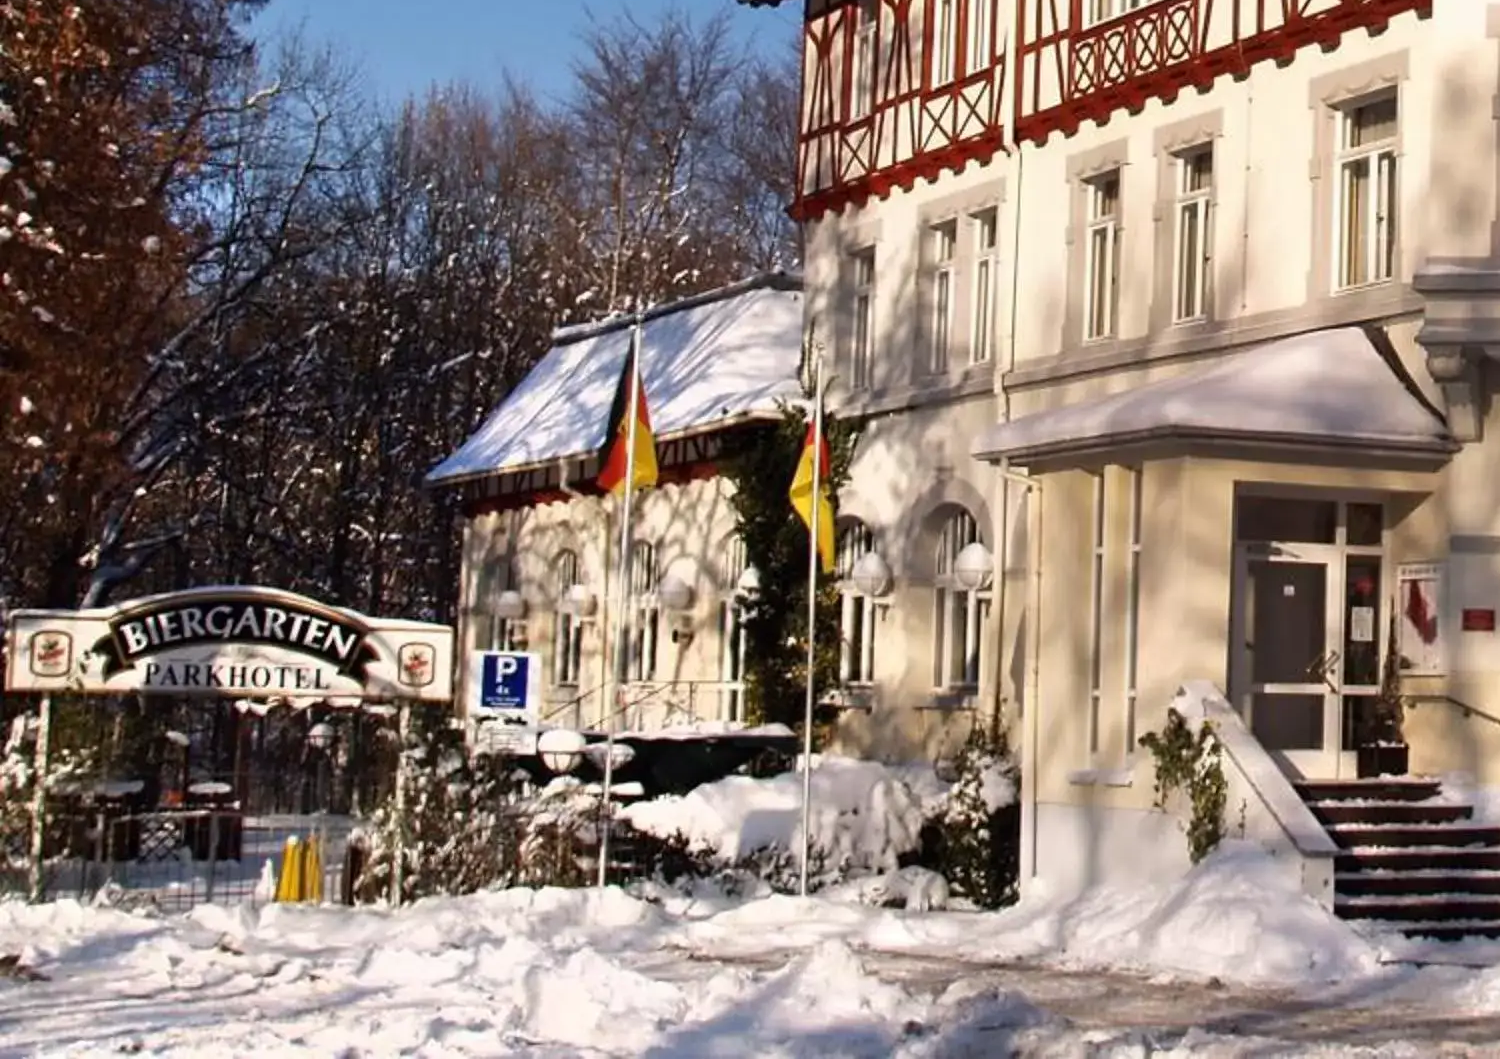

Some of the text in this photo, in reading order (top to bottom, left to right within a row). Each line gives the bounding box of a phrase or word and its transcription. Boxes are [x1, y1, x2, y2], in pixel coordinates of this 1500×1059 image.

[120, 605, 357, 660] BIERGARTEN
[144, 662, 330, 690] PARKHOTEL
[495, 657, 518, 683] P
